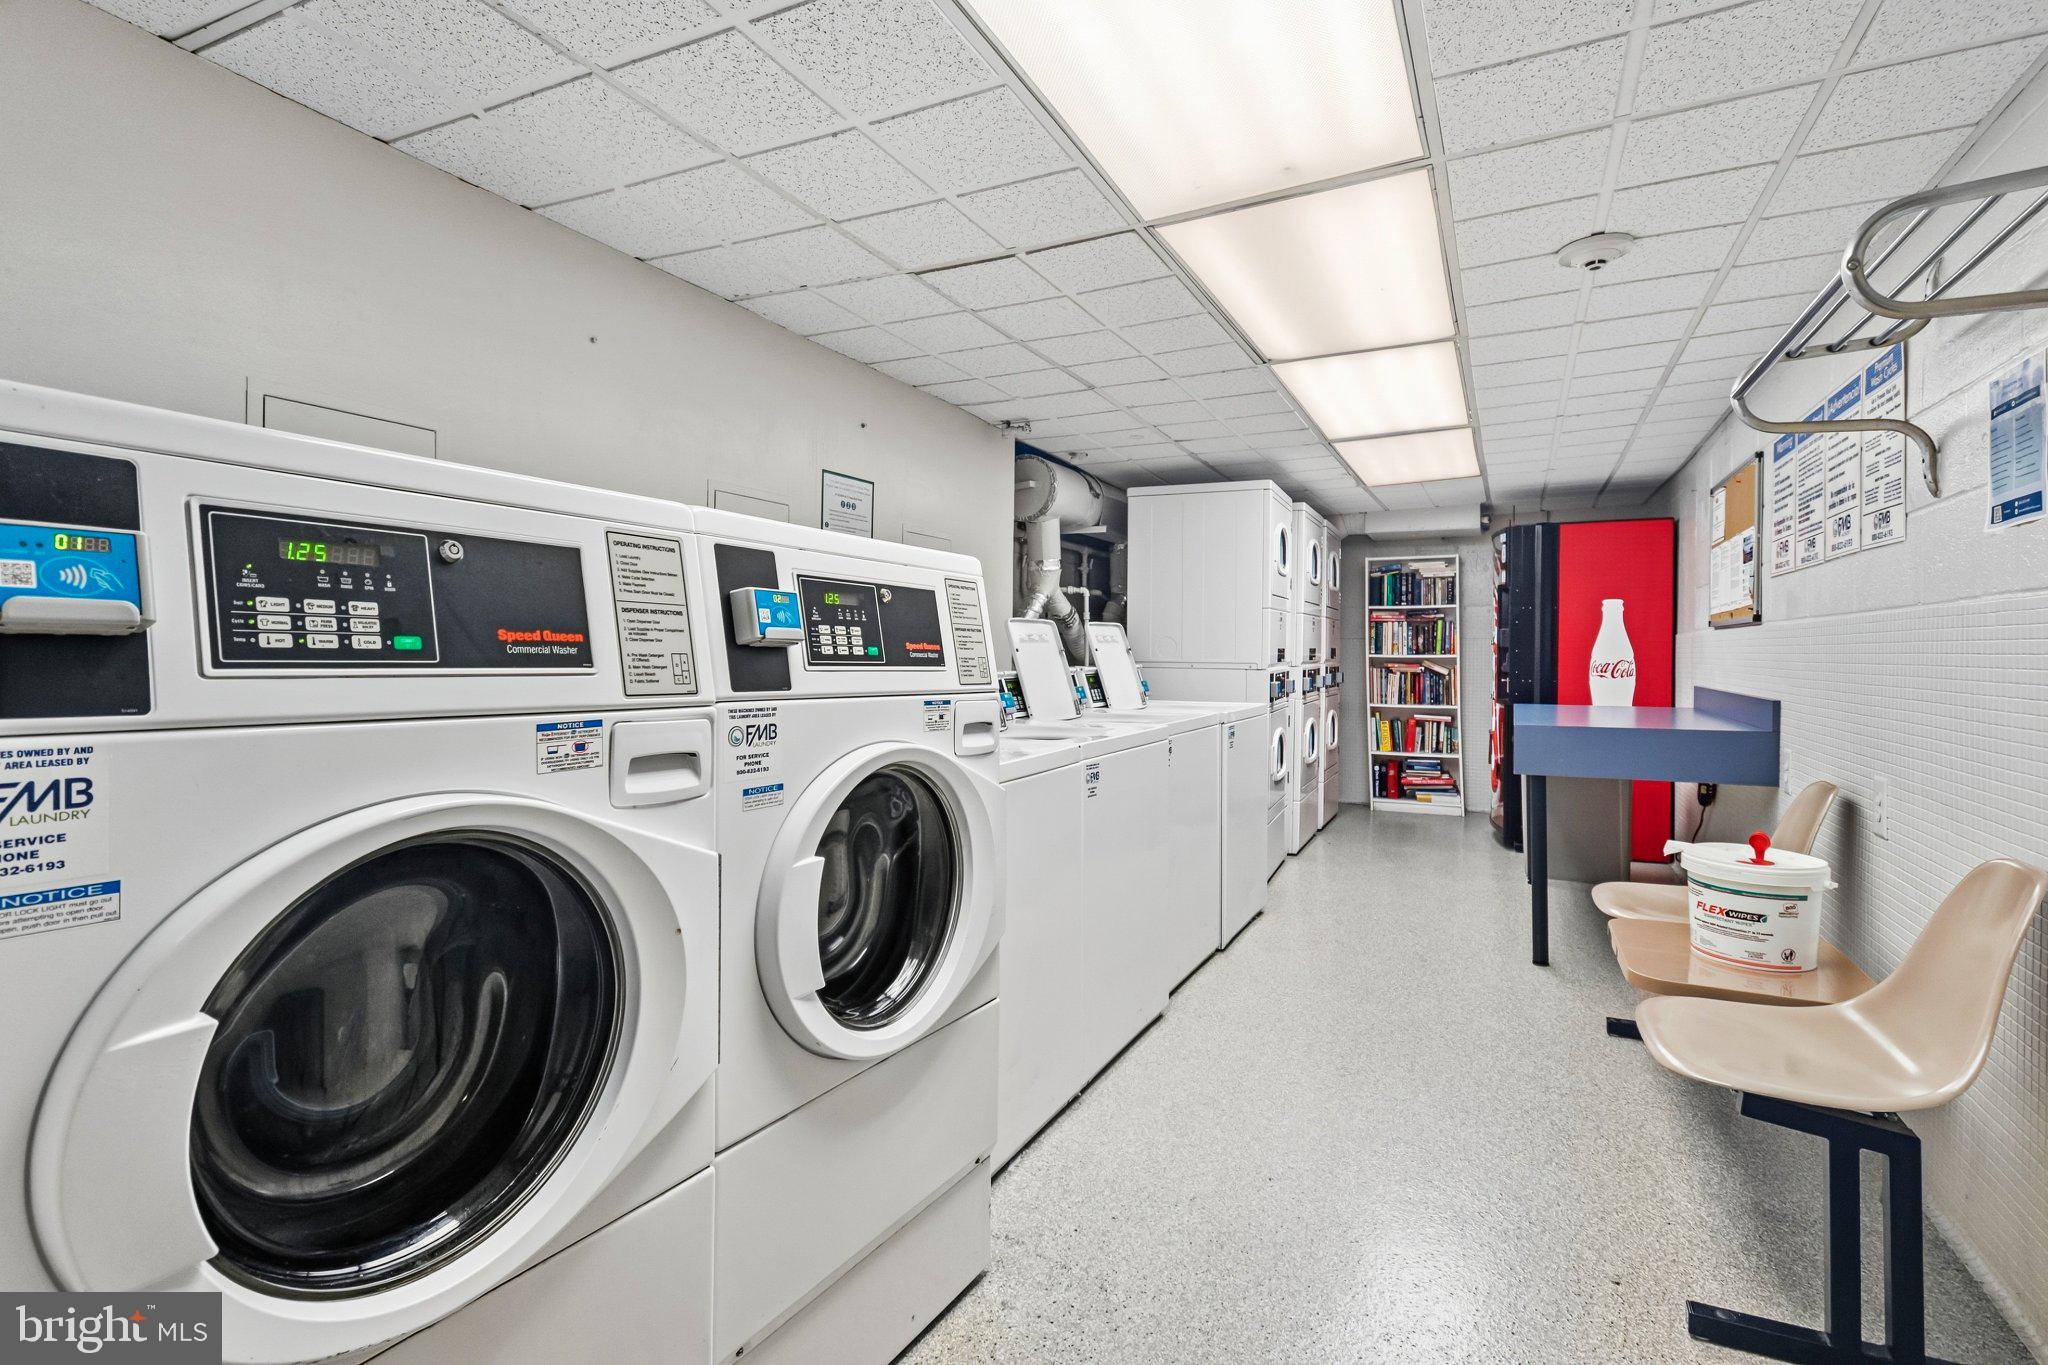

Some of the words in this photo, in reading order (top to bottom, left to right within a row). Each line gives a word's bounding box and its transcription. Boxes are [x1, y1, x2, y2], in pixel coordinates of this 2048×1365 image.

[287, 542, 326, 562] 1.25
[613, 540, 641, 549] OPERATING
[642, 544, 676, 553] INSTRUCTIONS
[498, 629, 540, 642] Speed
[542, 630, 584, 642] Queen
[506, 644, 550, 654] Commercial
[552, 646, 578, 654] Washer
[746, 723, 778, 746] FMB
[753, 740, 776, 748] LAUNDRY
[17, 748, 54, 758] OWNED
[57, 747, 70, 756] BY
[74, 746, 94, 755] AND
[748, 752, 770, 760] SERVICE
[4, 760, 32, 770] AREA
[36, 758, 74, 768] LEASED
[77, 757, 90, 766] BY
[749, 785, 778, 795] NOTICE
[10, 809, 91, 827] LAUNDRY
[2, 884, 104, 908] NOTICE
[15, 907, 40, 917] LOCK
[41, 903, 67, 913] LIGHT
[1696, 900, 1727, 917] FLEX
[1728, 911, 1759, 922] WIPES
[12, 912, 54, 926] attempting
[66, 910, 84, 918] open
[44, 920, 62, 928] door
